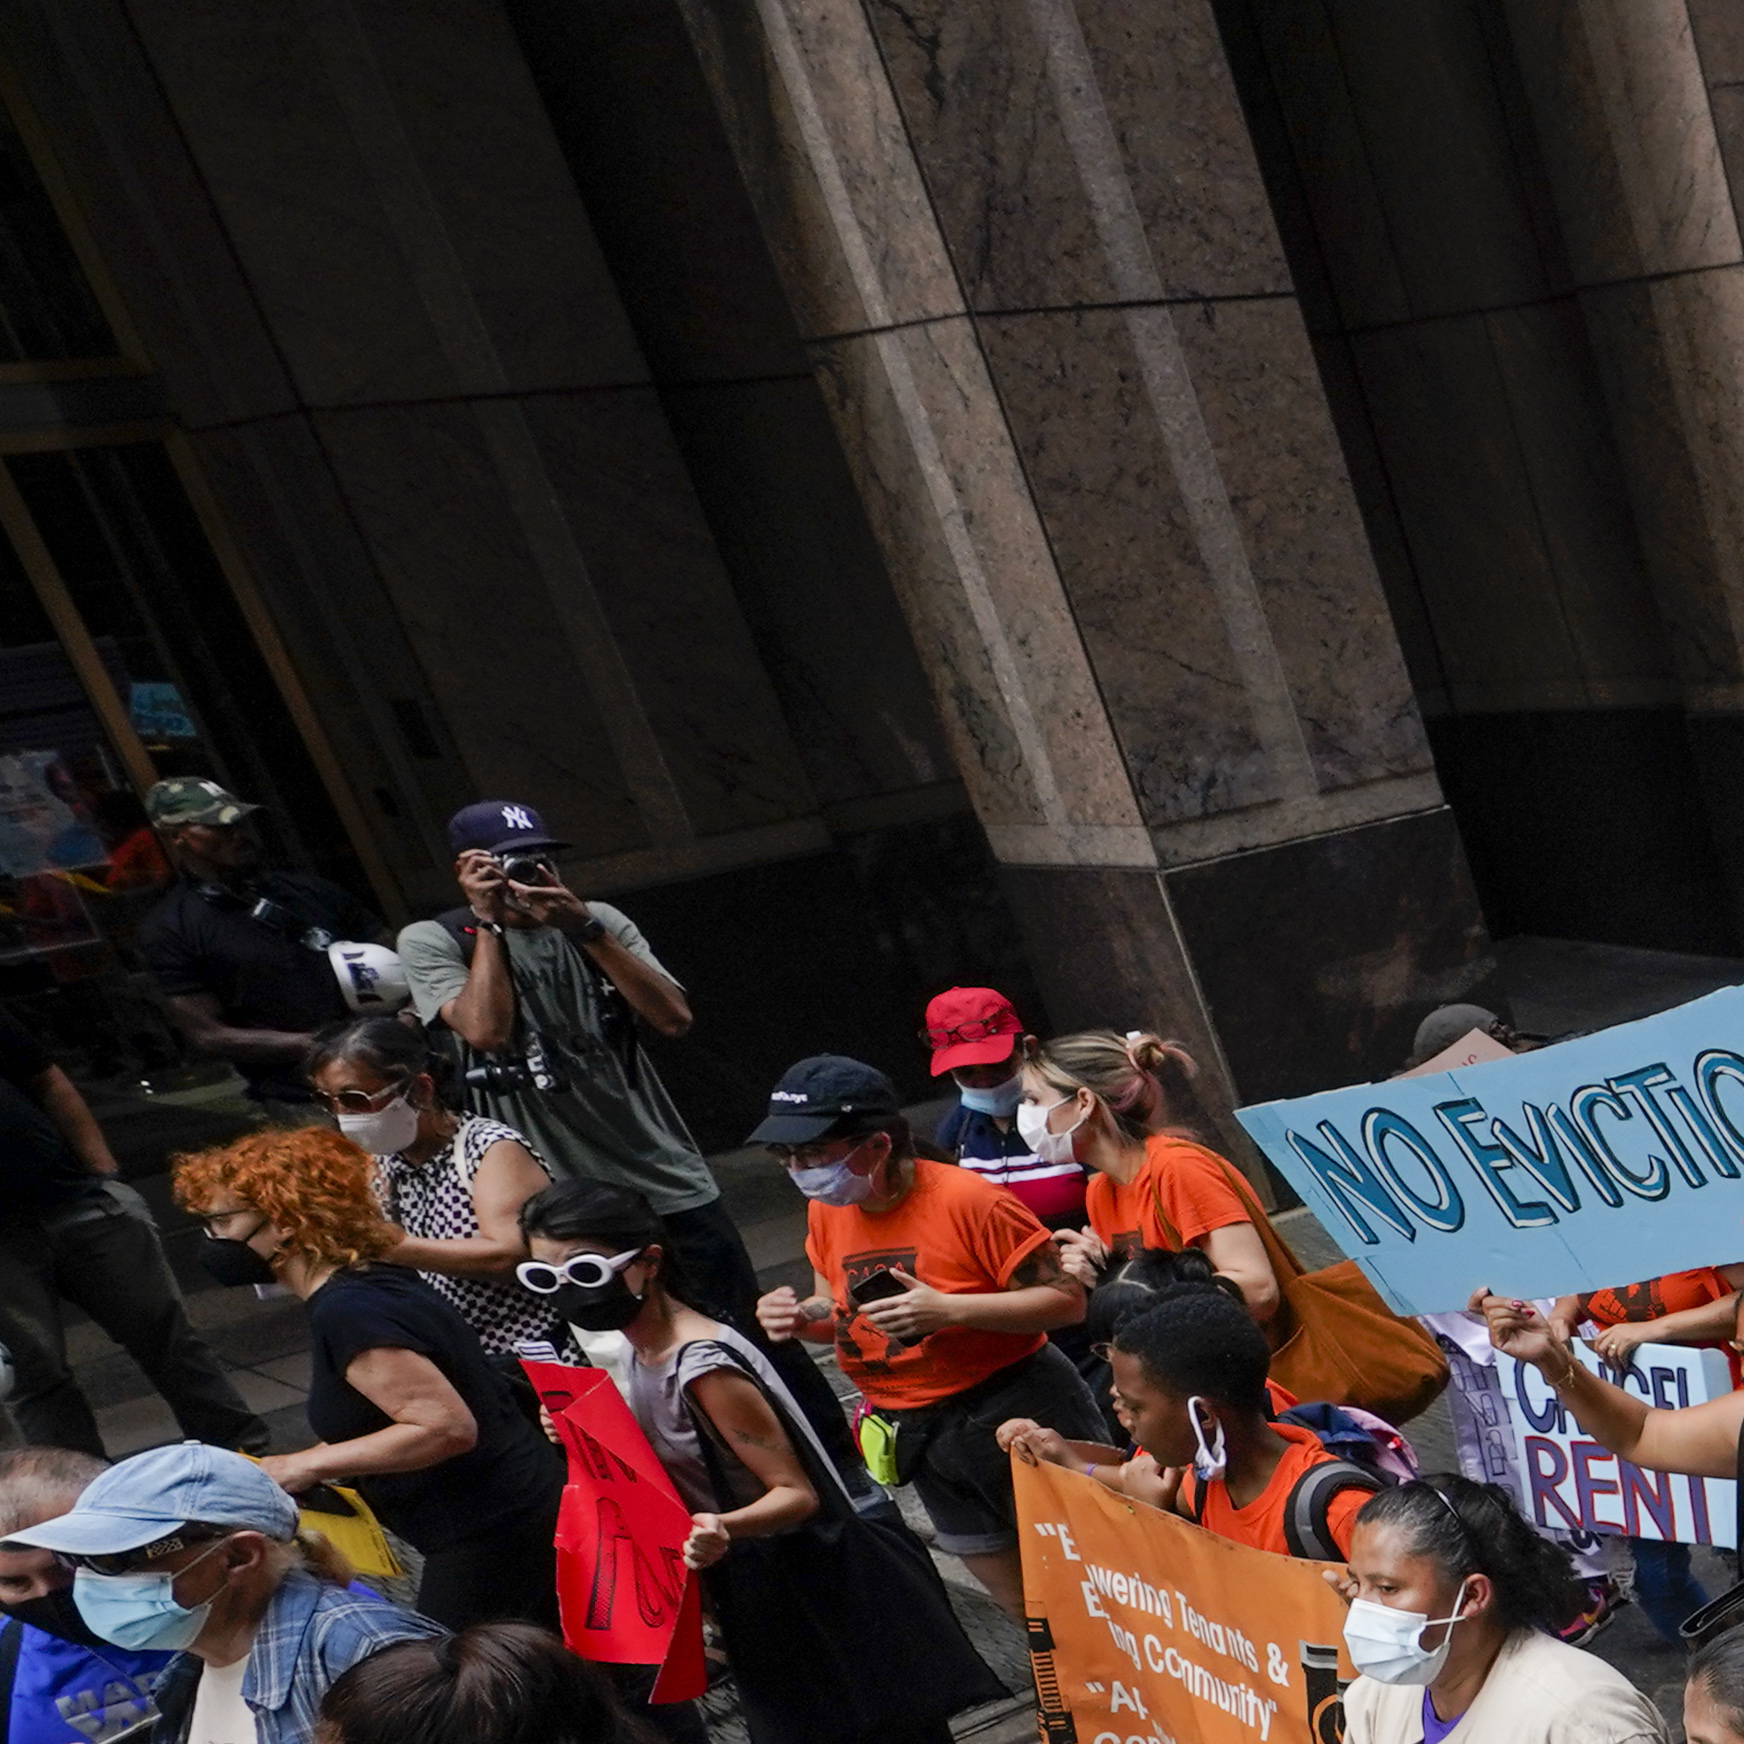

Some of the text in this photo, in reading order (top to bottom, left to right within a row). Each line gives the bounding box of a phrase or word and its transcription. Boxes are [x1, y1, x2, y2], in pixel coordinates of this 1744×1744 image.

[502, 804, 534, 831] NY
[1285, 1105, 1466, 1246] NO
[1175, 1590, 1291, 1688] Tenants &
